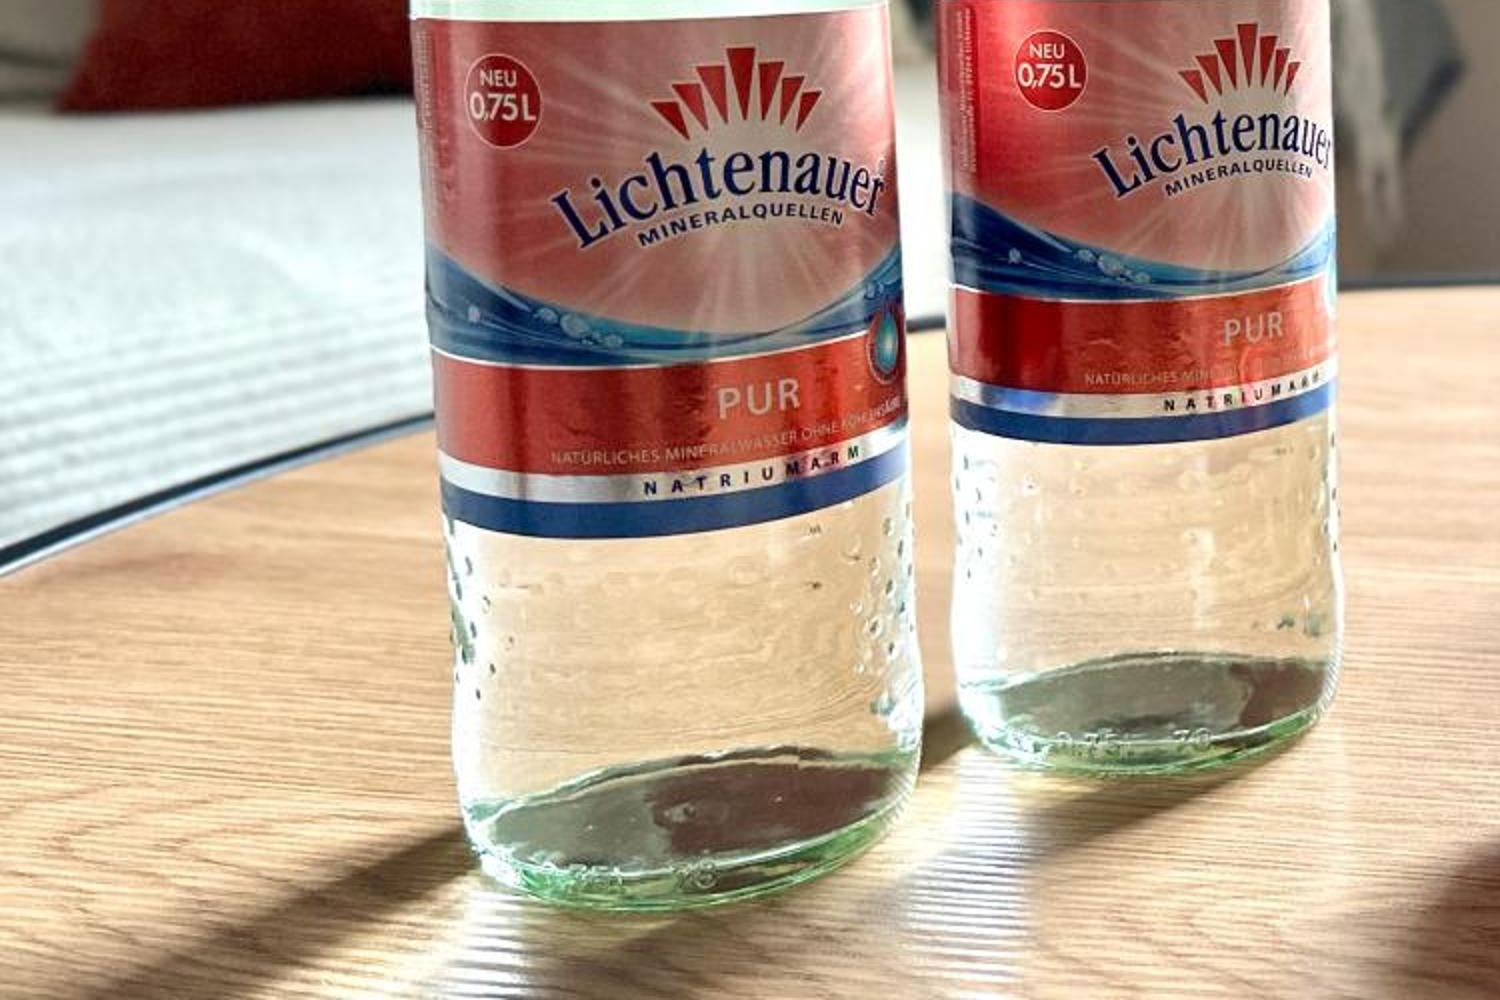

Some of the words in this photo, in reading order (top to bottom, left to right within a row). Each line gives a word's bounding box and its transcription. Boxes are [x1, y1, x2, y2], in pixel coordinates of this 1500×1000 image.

[1030, 43, 1065, 59] NEU
[479, 70, 517, 87] NEU
[1093, 110, 1331, 198] Lichtenauer
[551, 147, 885, 248] Lichtenauer
[1165, 158, 1313, 197] MINERALQUELLEN
[638, 203, 844, 247] MINERALQUELLEN
[1224, 311, 1283, 345] PUR
[718, 377, 800, 420] PUR
[551, 447, 661, 466] NATÜRLICHES
[644, 445, 860, 495] NATRIUMARM
